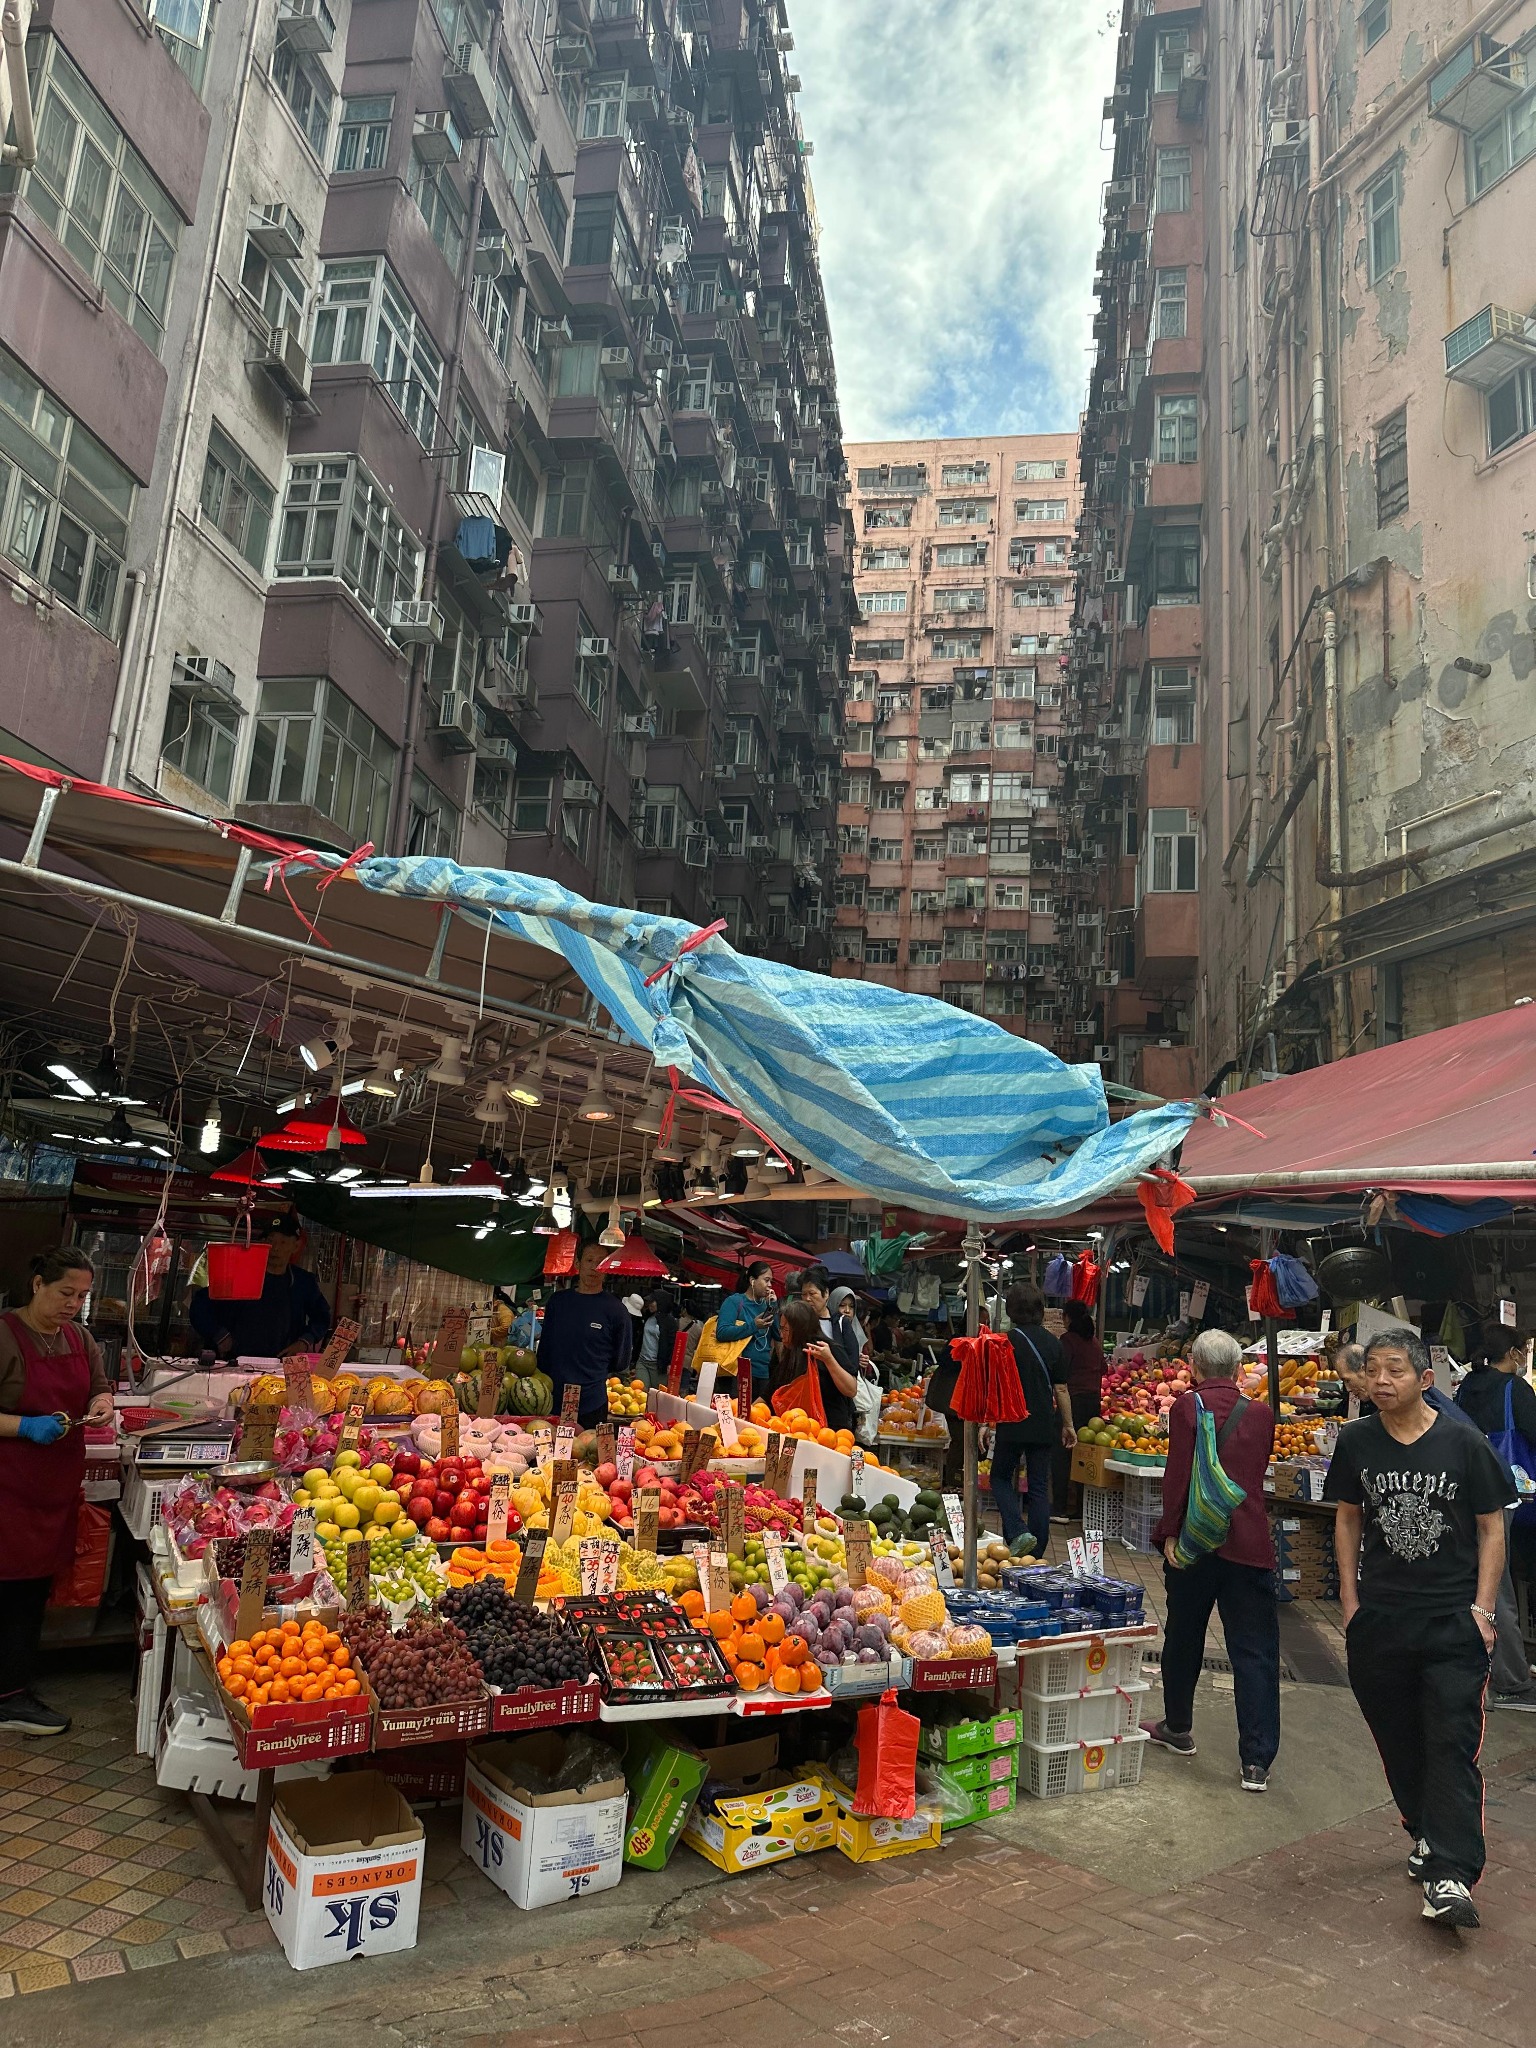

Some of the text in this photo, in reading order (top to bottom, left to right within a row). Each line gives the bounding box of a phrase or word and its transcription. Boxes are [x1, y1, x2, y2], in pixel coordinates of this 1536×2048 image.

[350, 1406, 364, 1417] 50
[562, 1494, 574, 1504] 40
[644, 1498, 654, 1510] 16
[294, 1506, 316, 1521] 特價
[298, 1520, 310, 1532] 58
[1090, 1542, 1100, 1555] 15
[604, 1552, 617, 1564] 60
[586, 1560, 599, 1571] 35
[924, 1670, 966, 1682] FamilyTree
[500, 1701, 556, 1716] FamilyTree
[382, 1715, 456, 1731] YummyPrune
[256, 1734, 322, 1751] FamilyTree
[793, 1790, 817, 1803] Zespri
[475, 1813, 504, 1868] sk
[742, 1850, 761, 1861] Zespri
[326, 1867, 405, 1888] ORANGES
[569, 1874, 591, 1894] sk
[324, 1890, 400, 1952] sk
